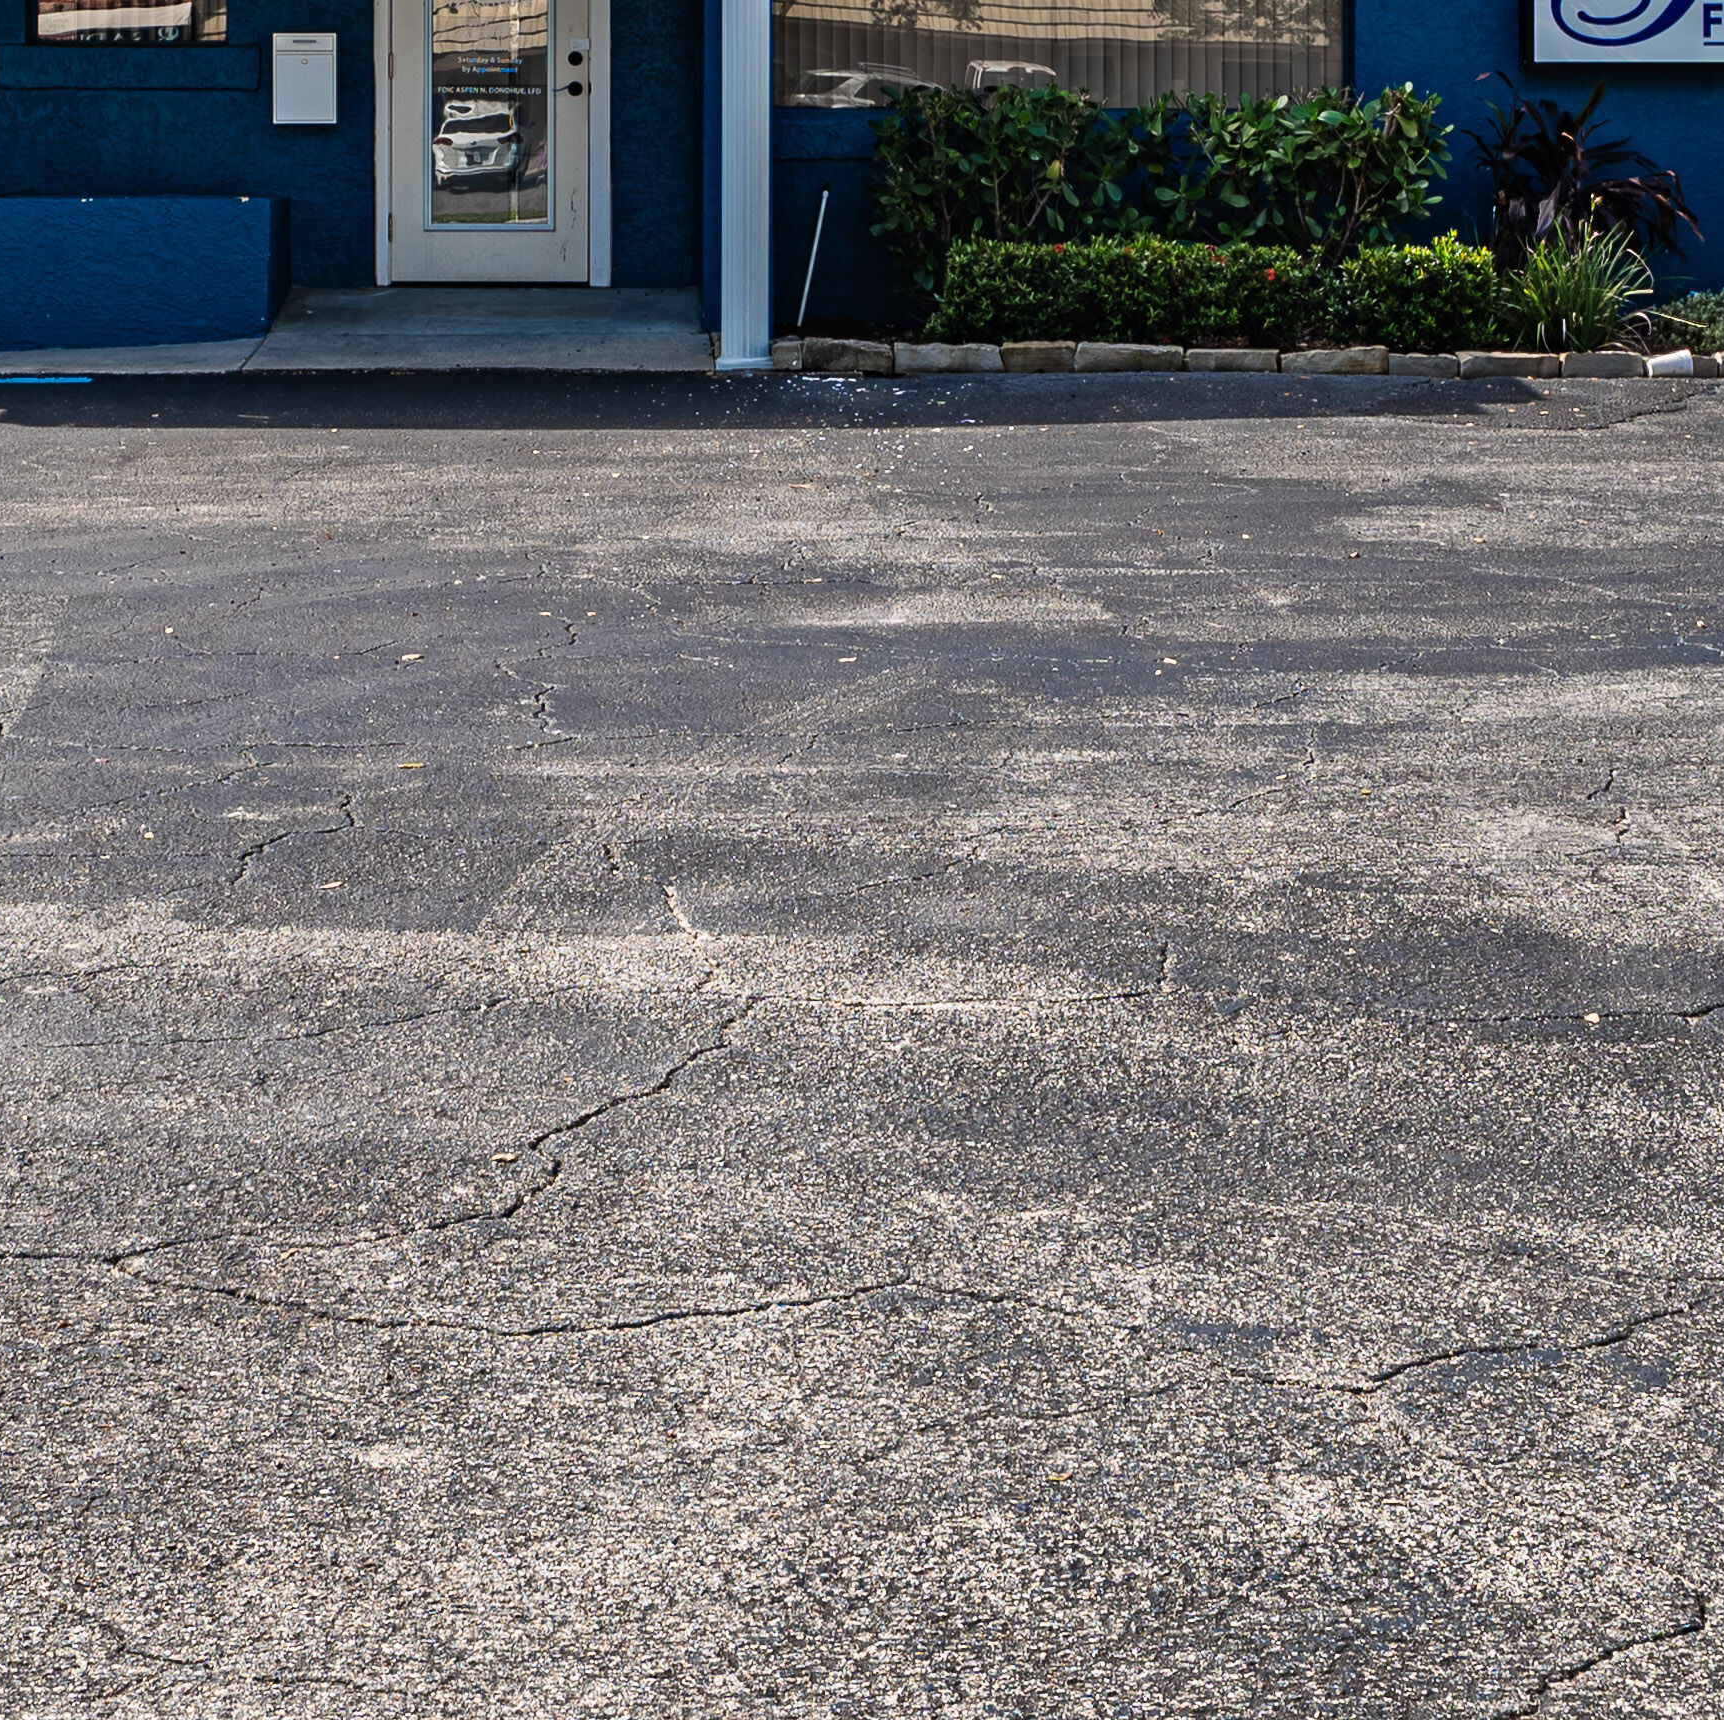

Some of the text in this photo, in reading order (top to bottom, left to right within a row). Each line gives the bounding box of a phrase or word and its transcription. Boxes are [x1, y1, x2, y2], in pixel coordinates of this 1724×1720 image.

[457, 56, 489, 64] Saturday
[497, 56, 523, 65] Sunday
[462, 65, 518, 73] by Appointment
